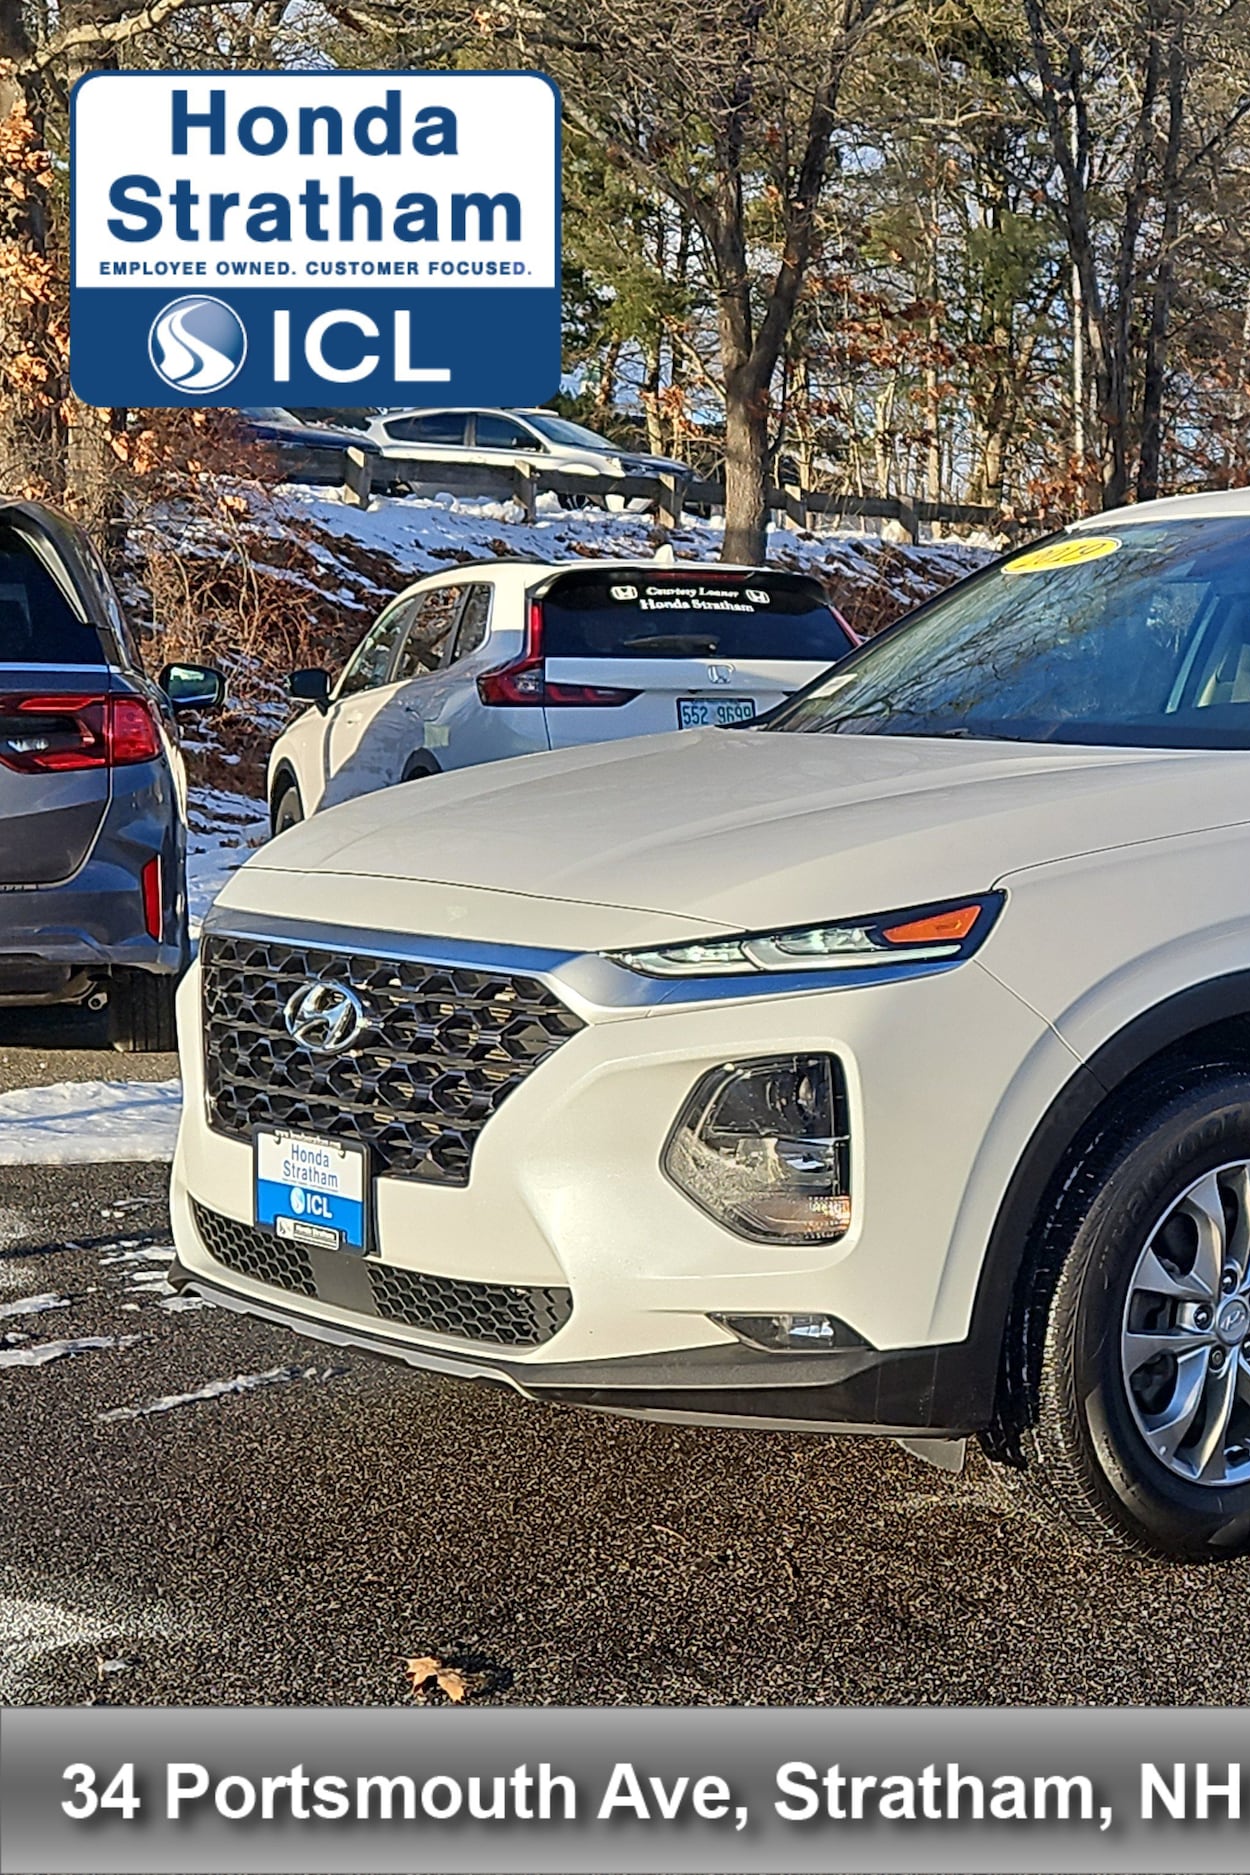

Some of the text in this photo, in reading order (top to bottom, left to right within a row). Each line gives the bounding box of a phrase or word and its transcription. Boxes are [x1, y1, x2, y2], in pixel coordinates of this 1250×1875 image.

[640, 598, 755, 613] Honda Stratham
[682, 705, 709, 725] 552
[291, 1143, 330, 1168] Honda
[282, 1160, 338, 1188] Stratham
[306, 1193, 333, 1219] ICL
